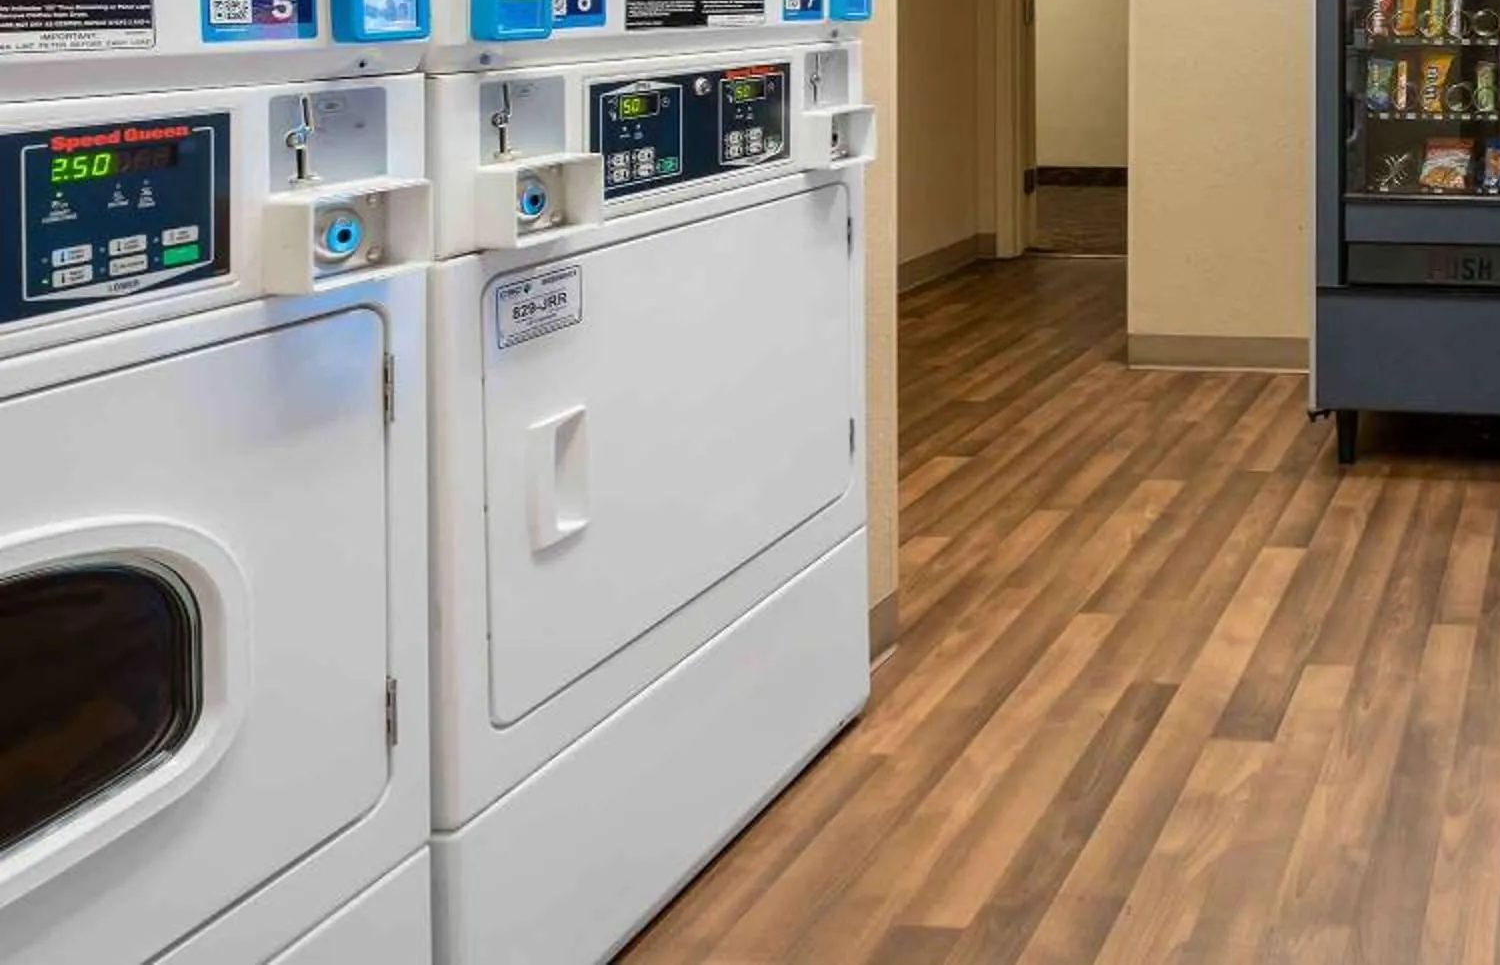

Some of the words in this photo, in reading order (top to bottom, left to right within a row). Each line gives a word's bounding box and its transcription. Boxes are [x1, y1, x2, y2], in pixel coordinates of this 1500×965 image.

[50, 131, 121, 152] Speed
[123, 125, 190, 143] Queen
[51, 152, 112, 182] 2.50
